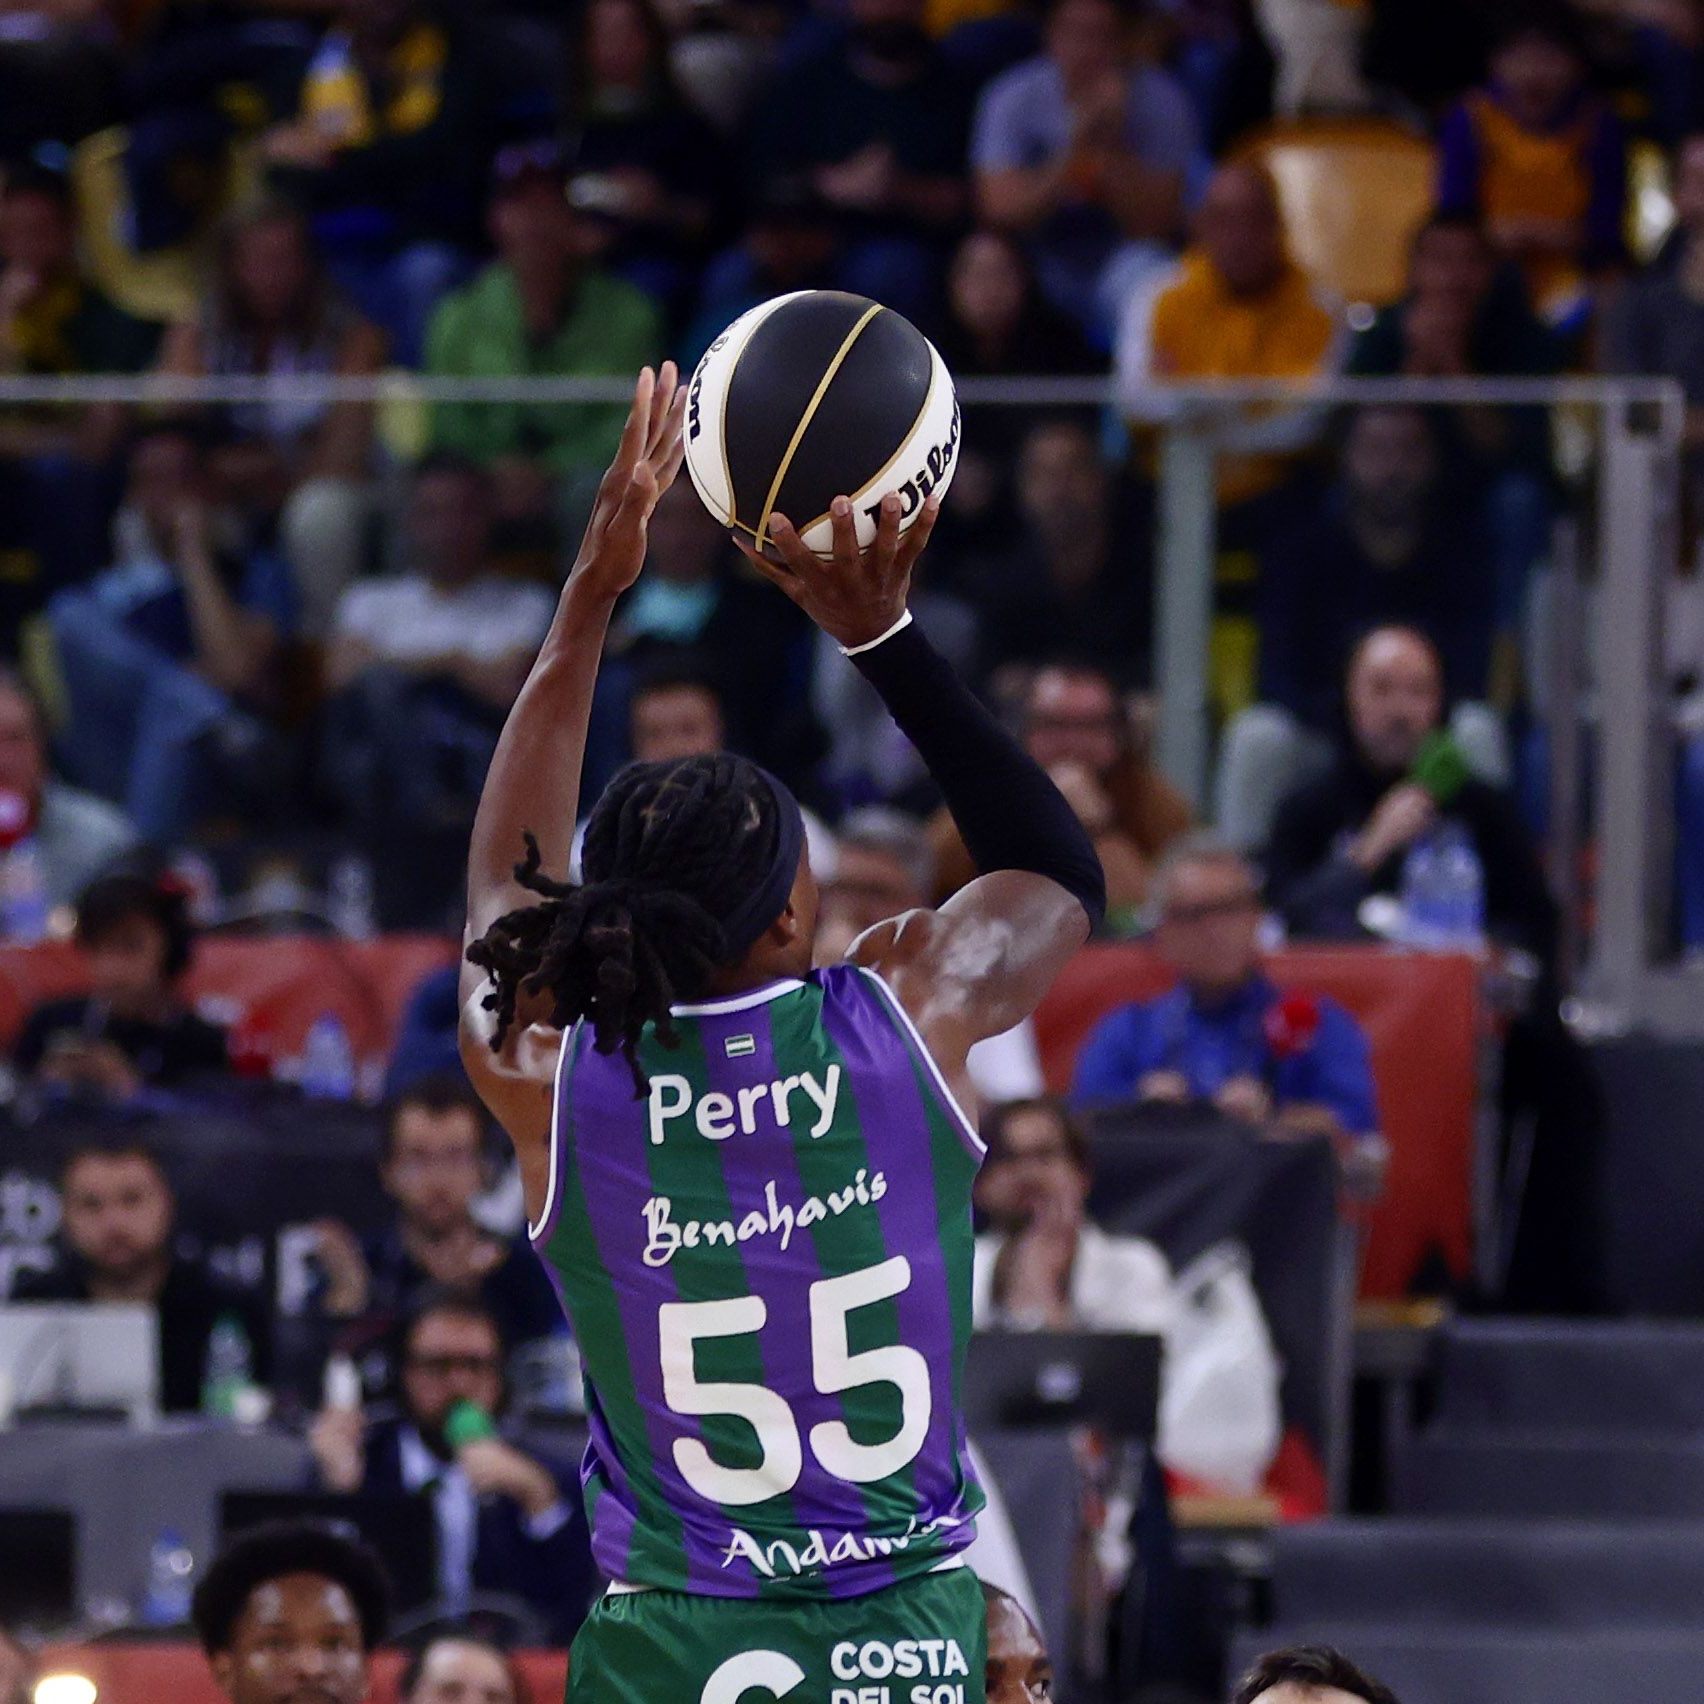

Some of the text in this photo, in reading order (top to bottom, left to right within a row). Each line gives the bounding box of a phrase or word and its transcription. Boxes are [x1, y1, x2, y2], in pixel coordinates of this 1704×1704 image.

[648, 1065, 841, 1146] Perry
[658, 1255, 932, 1506] 55
[831, 1638, 969, 1681] COSTA
